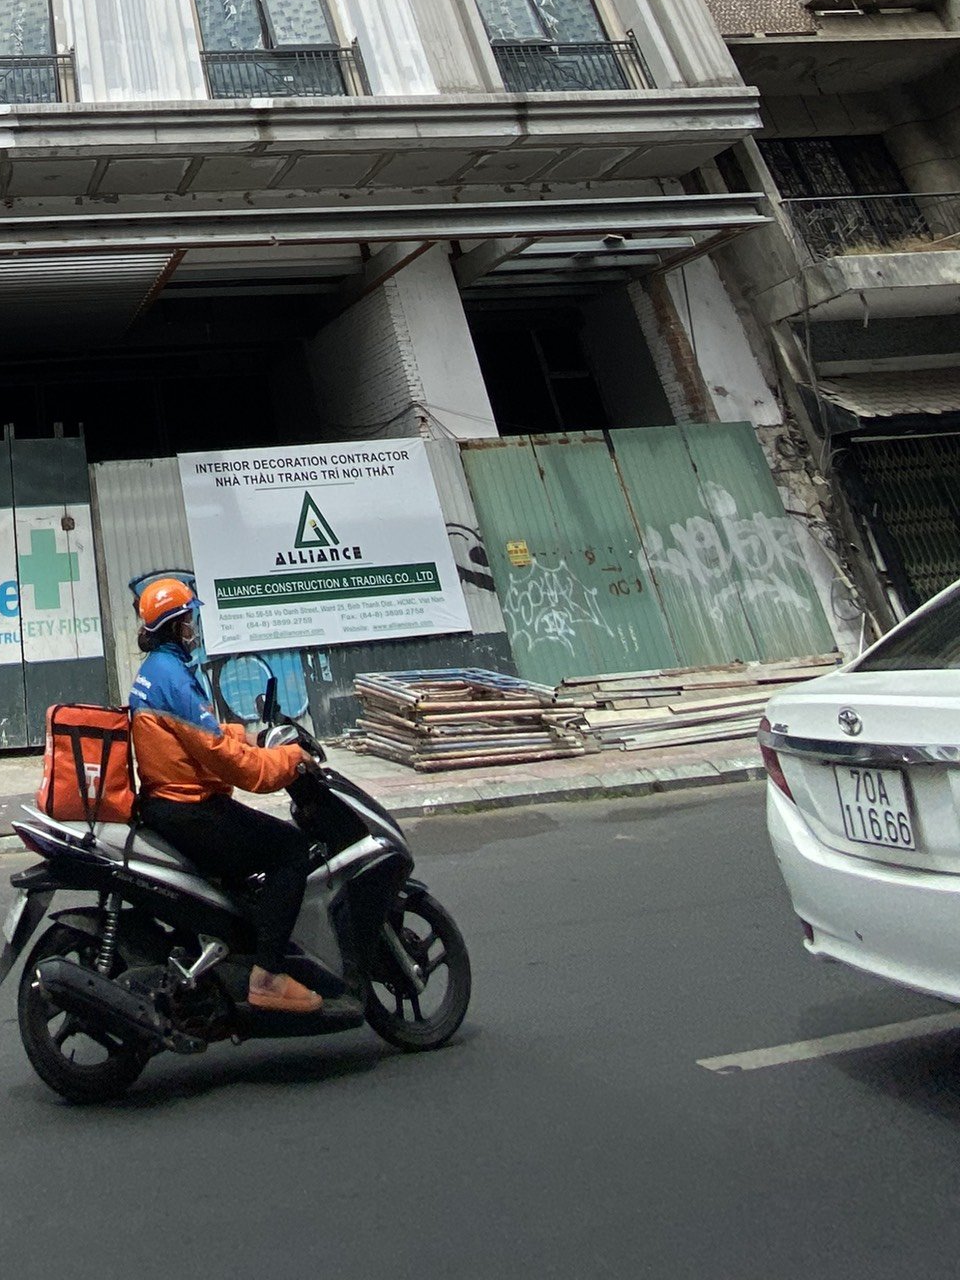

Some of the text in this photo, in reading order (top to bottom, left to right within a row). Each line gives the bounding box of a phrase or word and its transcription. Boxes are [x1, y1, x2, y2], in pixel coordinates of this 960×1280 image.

[195, 451, 409, 474] INTERIOR DECORATION CONTRACTOR
[215, 474, 240, 487] NHÀ
[277, 471, 318, 482] TRANG
[320, 467, 340, 479] TRÍ
[275, 546, 362, 566] ALLIANCE
[217, 583, 263, 597] ALLIANCE
[264, 578, 340, 593] CONSTRUCTION
[342, 577, 350, 587] &
[350, 573, 393, 586] TRADING
[416, 571, 434, 582] LTD
[59, 616, 99, 636] FIRST
[850, 768, 890, 806] 70A
[846, 804, 911, 845] 116.66
